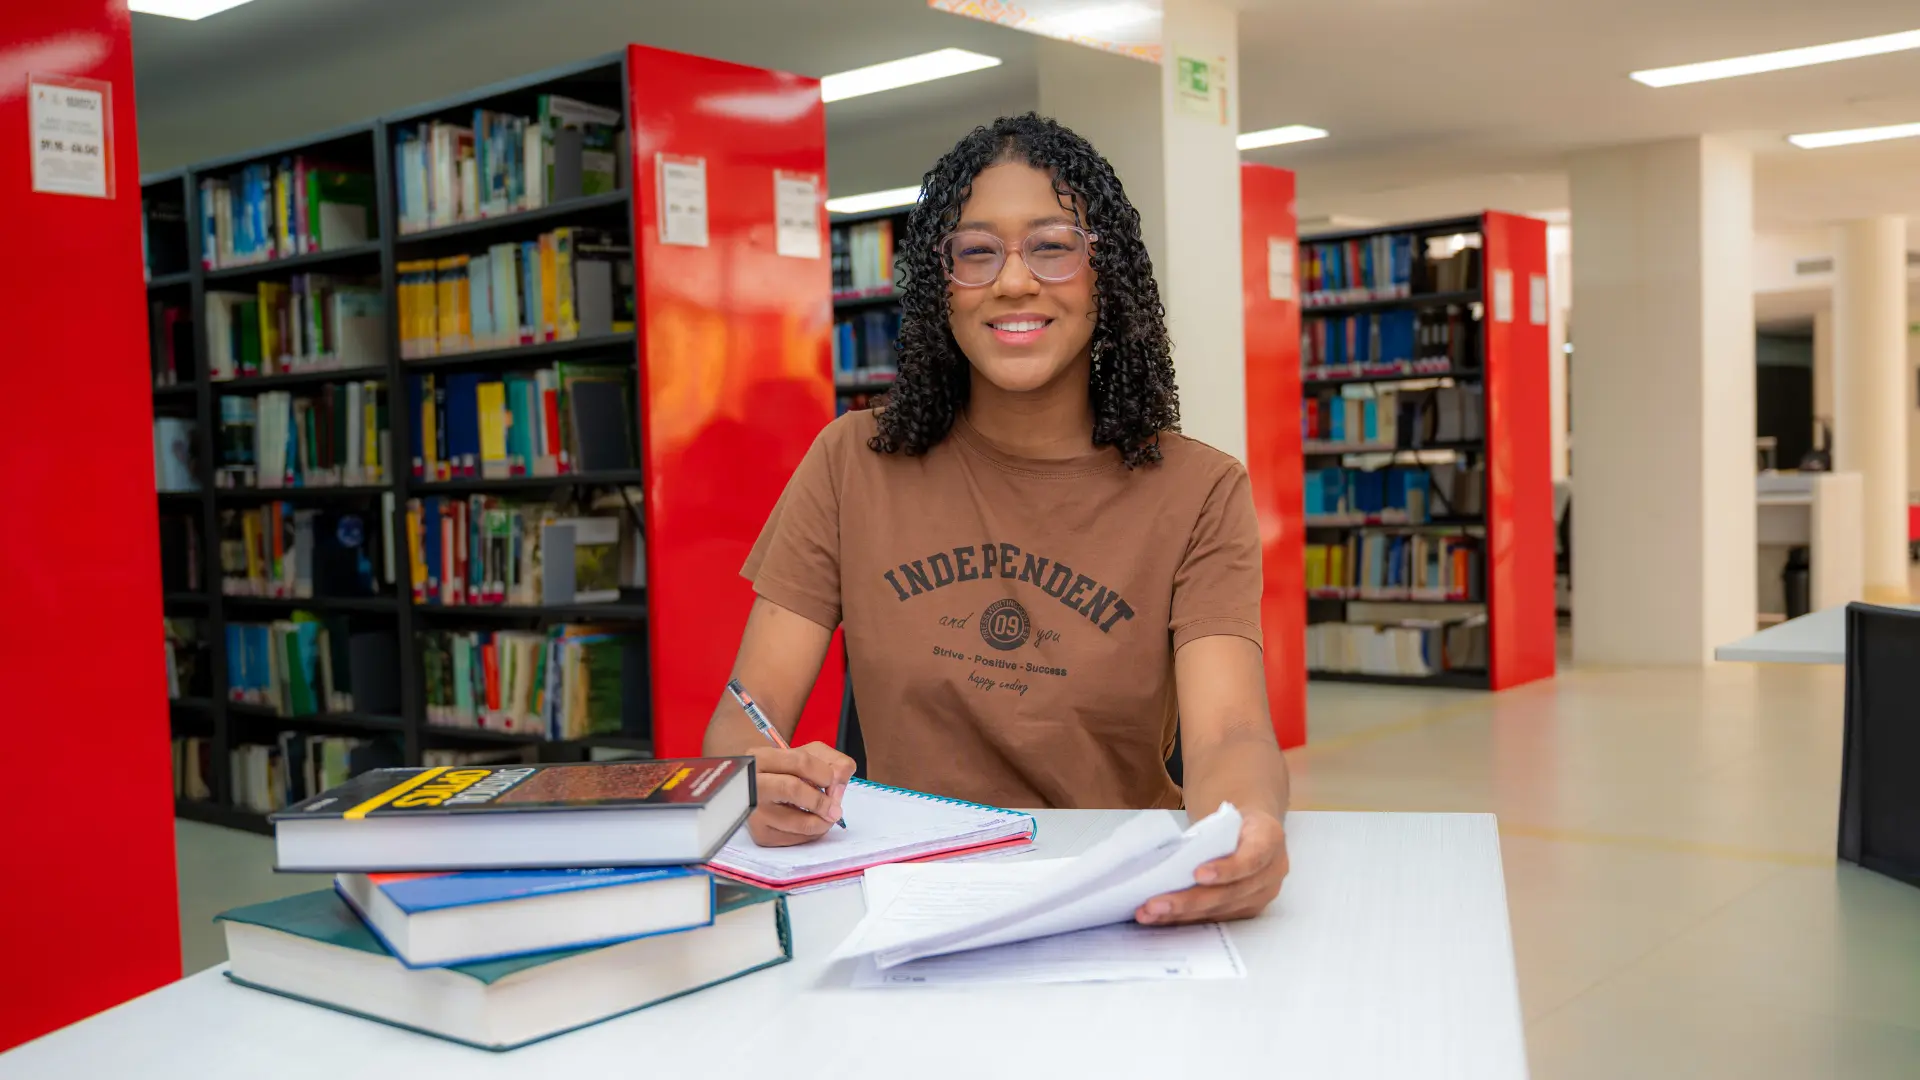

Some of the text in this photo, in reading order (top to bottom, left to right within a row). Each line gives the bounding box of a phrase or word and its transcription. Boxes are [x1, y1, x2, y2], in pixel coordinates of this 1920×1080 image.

[884, 542, 1135, 634] INDEPENDENT
[938, 612, 974, 629] and
[980, 613, 990, 640] PRESS
[988, 600, 1018, 614] WRITING
[994, 614, 1019, 636] 09
[1033, 628, 1060, 648] you
[933, 646, 964, 660] Strive
[974, 655, 1017, 670] Positive
[1025, 662, 1067, 676] Success
[967, 669, 1028, 696] happy ending
[392, 769, 492, 808] OPTICS
